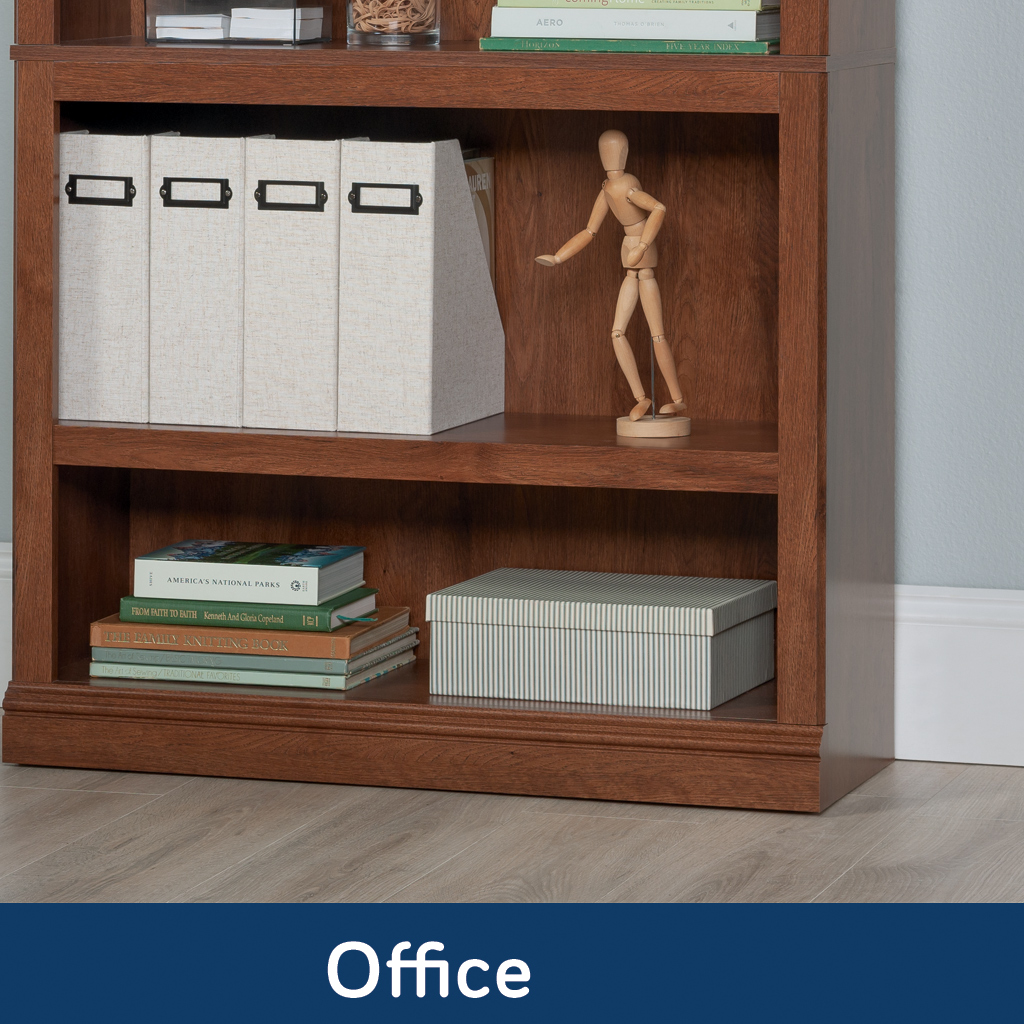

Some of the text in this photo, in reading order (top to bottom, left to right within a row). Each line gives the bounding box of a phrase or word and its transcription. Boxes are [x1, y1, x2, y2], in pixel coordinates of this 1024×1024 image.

[536, 18, 564, 27] AERO
[666, 42, 683, 50] FIVE
[688, 43, 710, 51] YEAR
[713, 43, 740, 51] INDEX
[166, 577, 210, 585] AMERICA'S
[212, 579, 253, 587] NATIONAL
[131, 606, 284, 625] FROM FAITH TO FAITH Kenneth And Gloria Copeland
[104, 631, 289, 652] THE FAMILY KNITTING BOOK
[102, 666, 114, 674] The
[206, 671, 241, 682] FAVORITES
